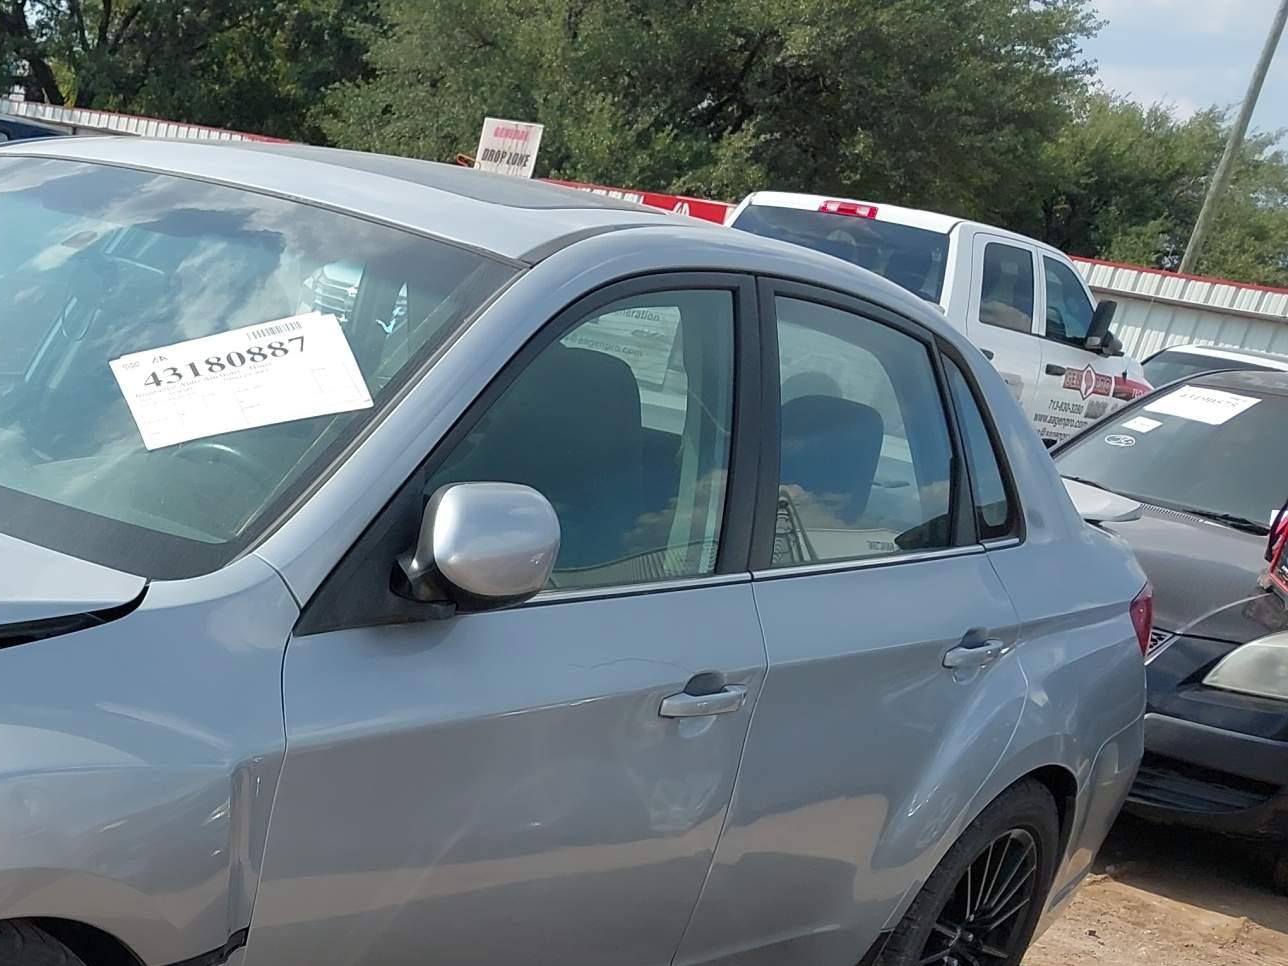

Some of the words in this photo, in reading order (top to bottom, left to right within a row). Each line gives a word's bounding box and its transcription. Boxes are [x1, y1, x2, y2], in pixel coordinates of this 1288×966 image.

[481, 148, 507, 164] DROP
[506, 151, 531, 168] ZONE
[143, 336, 305, 388] 43180887
